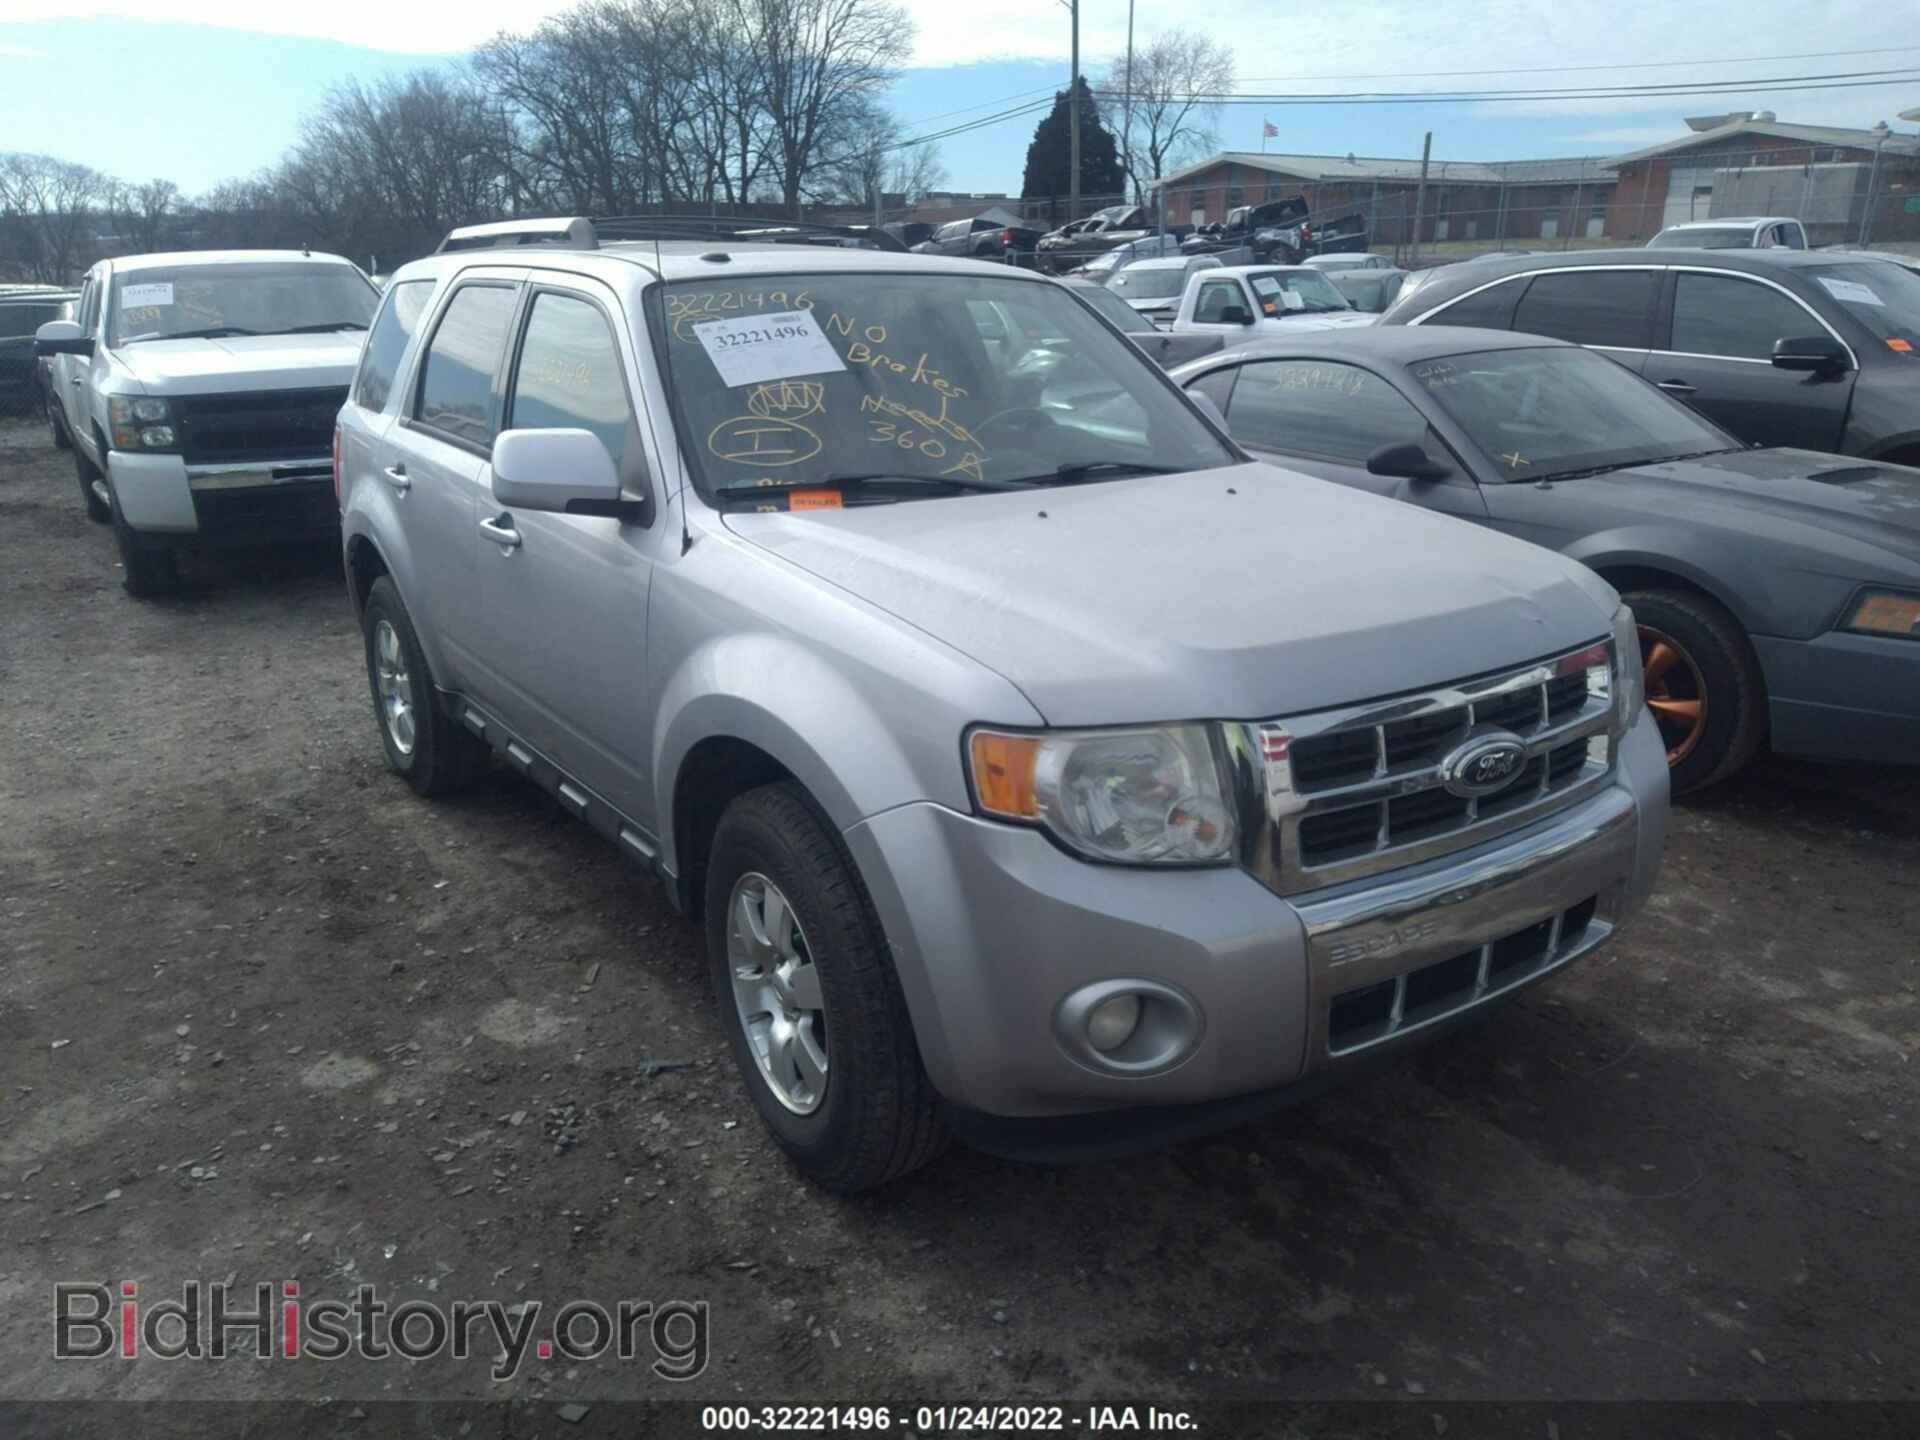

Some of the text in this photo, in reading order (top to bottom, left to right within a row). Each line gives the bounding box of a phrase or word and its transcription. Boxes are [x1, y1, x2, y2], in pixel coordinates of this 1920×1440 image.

[663, 290, 816, 317] 32221496
[713, 325, 809, 349] 32221496
[868, 420, 946, 458] 360
